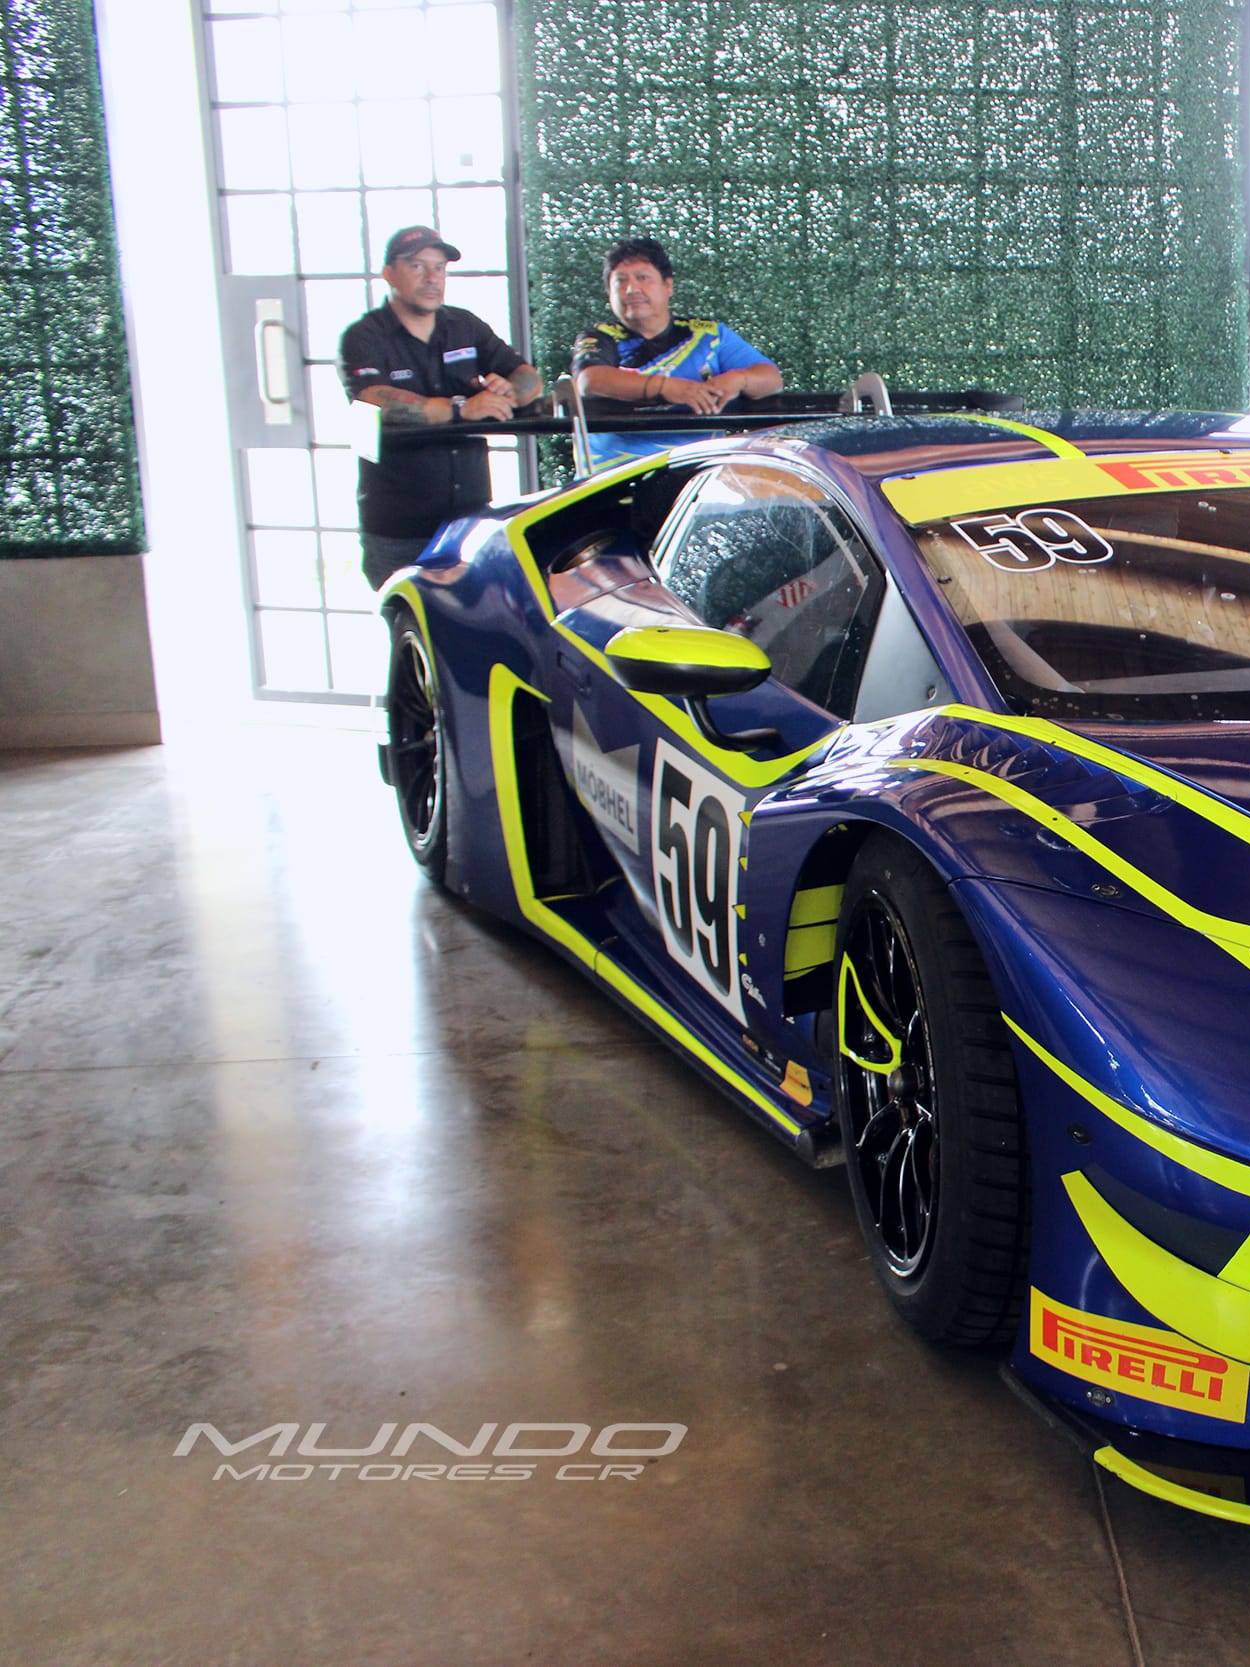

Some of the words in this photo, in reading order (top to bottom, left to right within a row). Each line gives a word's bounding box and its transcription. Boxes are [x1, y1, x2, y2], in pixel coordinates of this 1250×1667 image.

[951, 508, 1113, 573] 59
[658, 759, 731, 998] 59
[1042, 1307, 1229, 1402] PIRELLI
